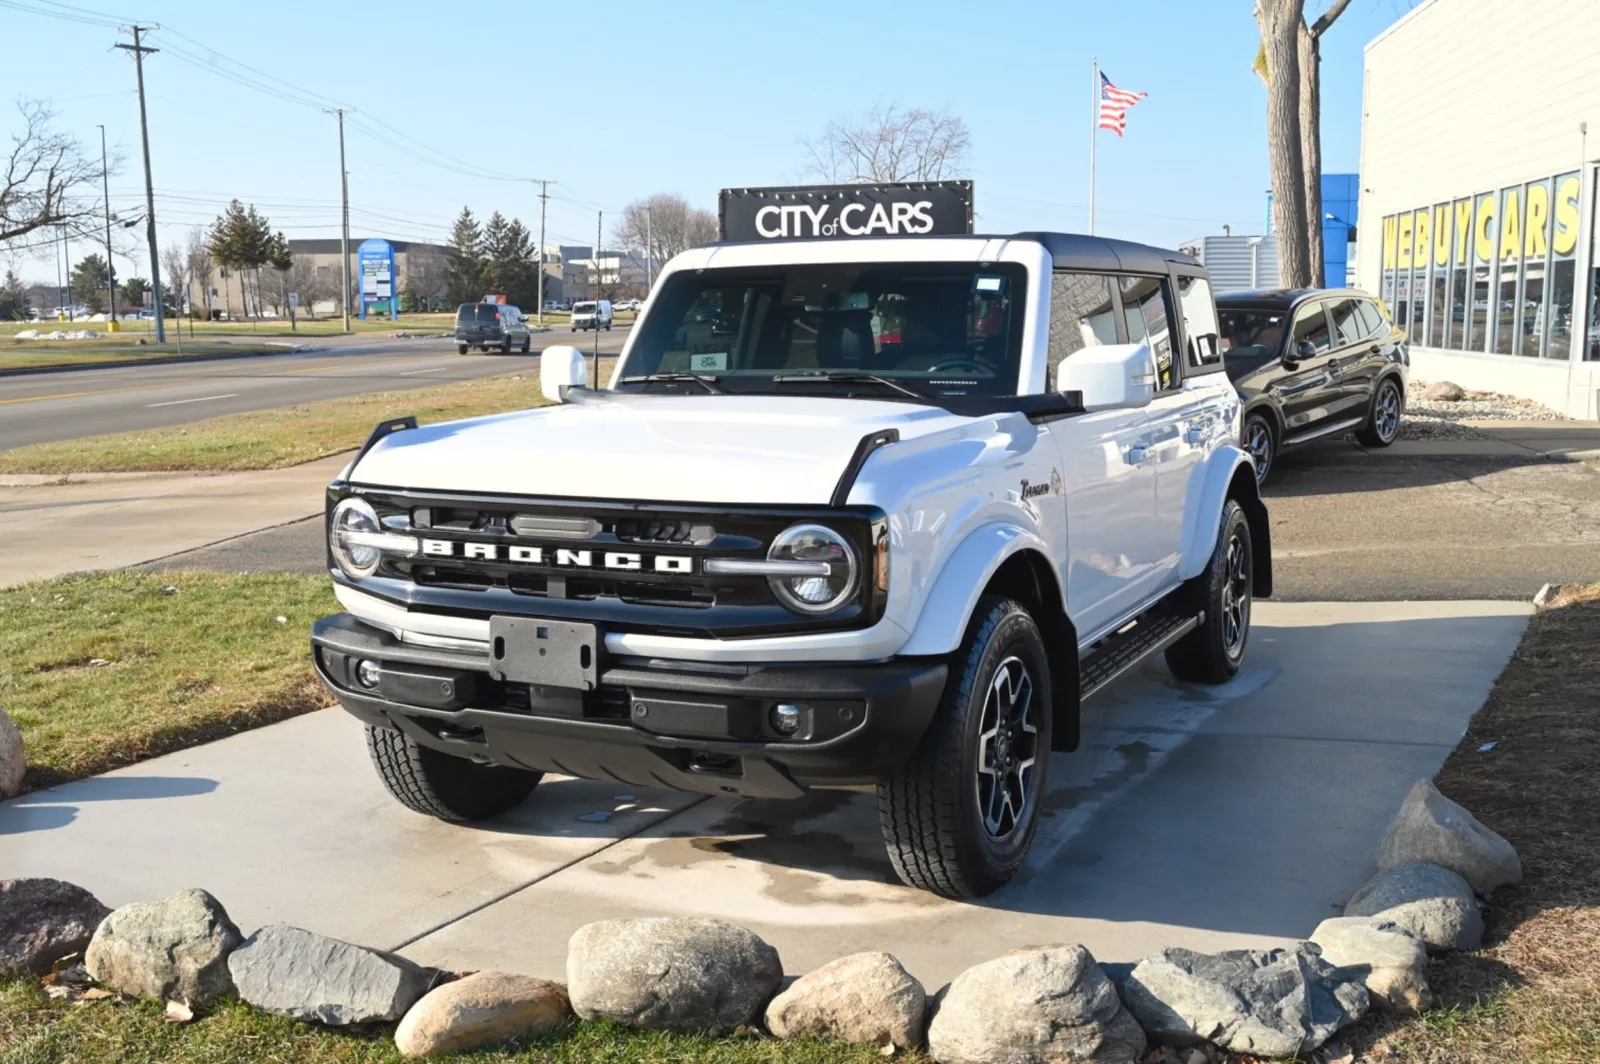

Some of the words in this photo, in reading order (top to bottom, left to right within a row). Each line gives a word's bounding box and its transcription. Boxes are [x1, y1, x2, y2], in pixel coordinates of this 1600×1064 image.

[755, 204, 829, 238] CITY
[821, 218, 839, 236] of
[839, 201, 934, 236] CARS
[1020, 479, 1050, 500] Bronco
[422, 538, 692, 573] BRONCO
